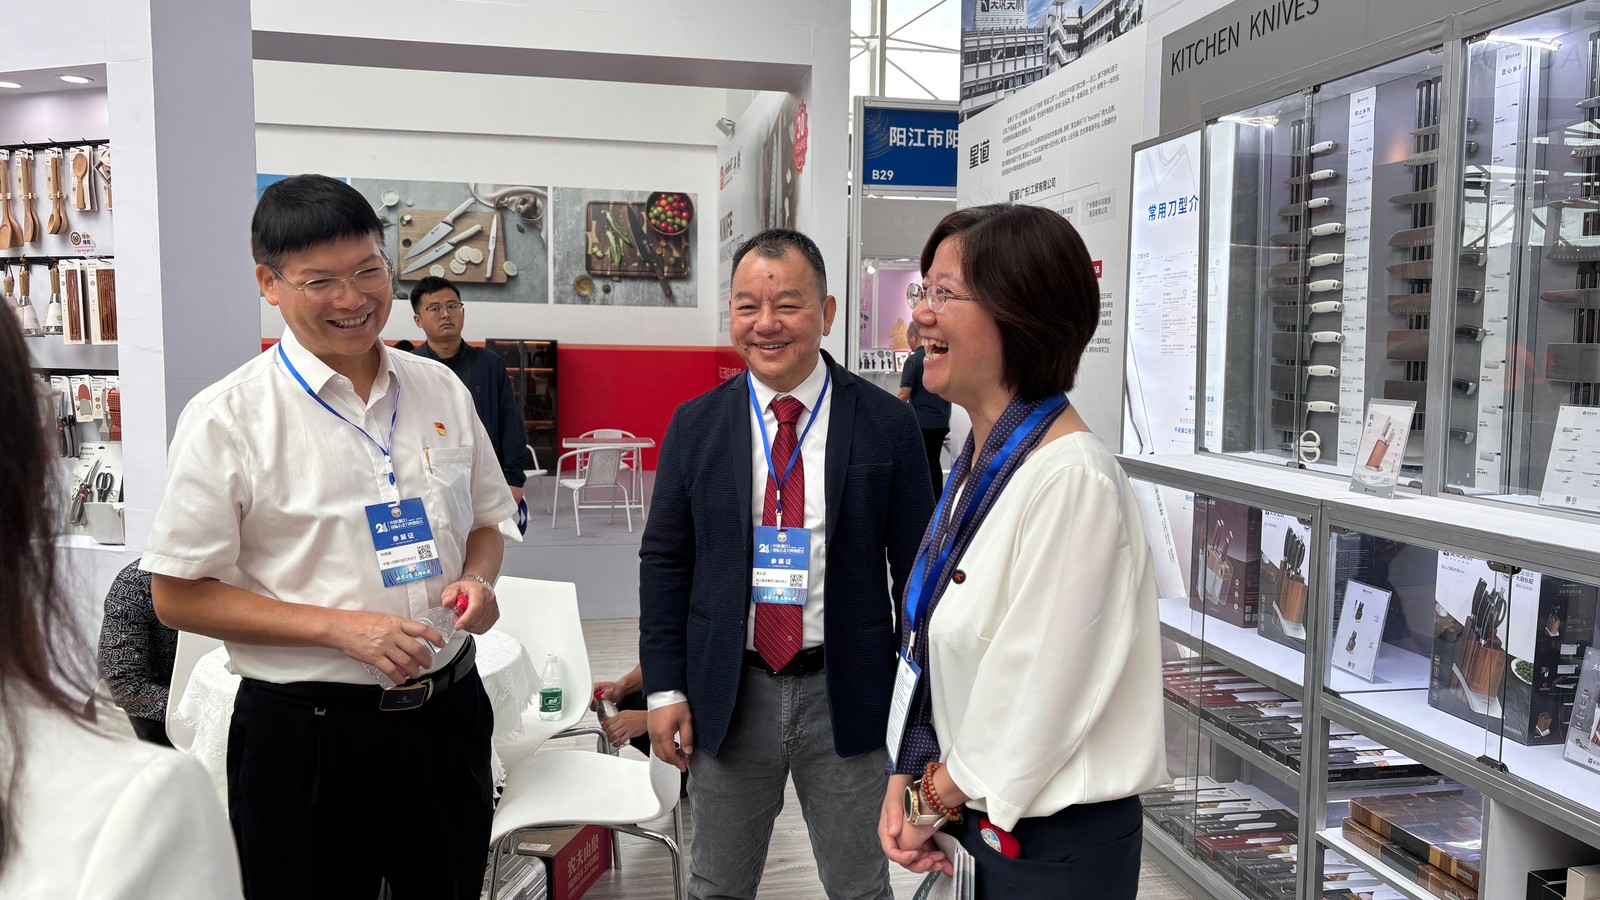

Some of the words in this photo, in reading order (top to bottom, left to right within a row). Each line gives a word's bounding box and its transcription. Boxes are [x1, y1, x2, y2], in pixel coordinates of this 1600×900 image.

[1171, 21, 1240, 76] KITCHEN
[1249, 0, 1320, 41] KNIVES
[872, 169, 894, 181] B29
[567, 833, 599, 878] 农夫山泉
